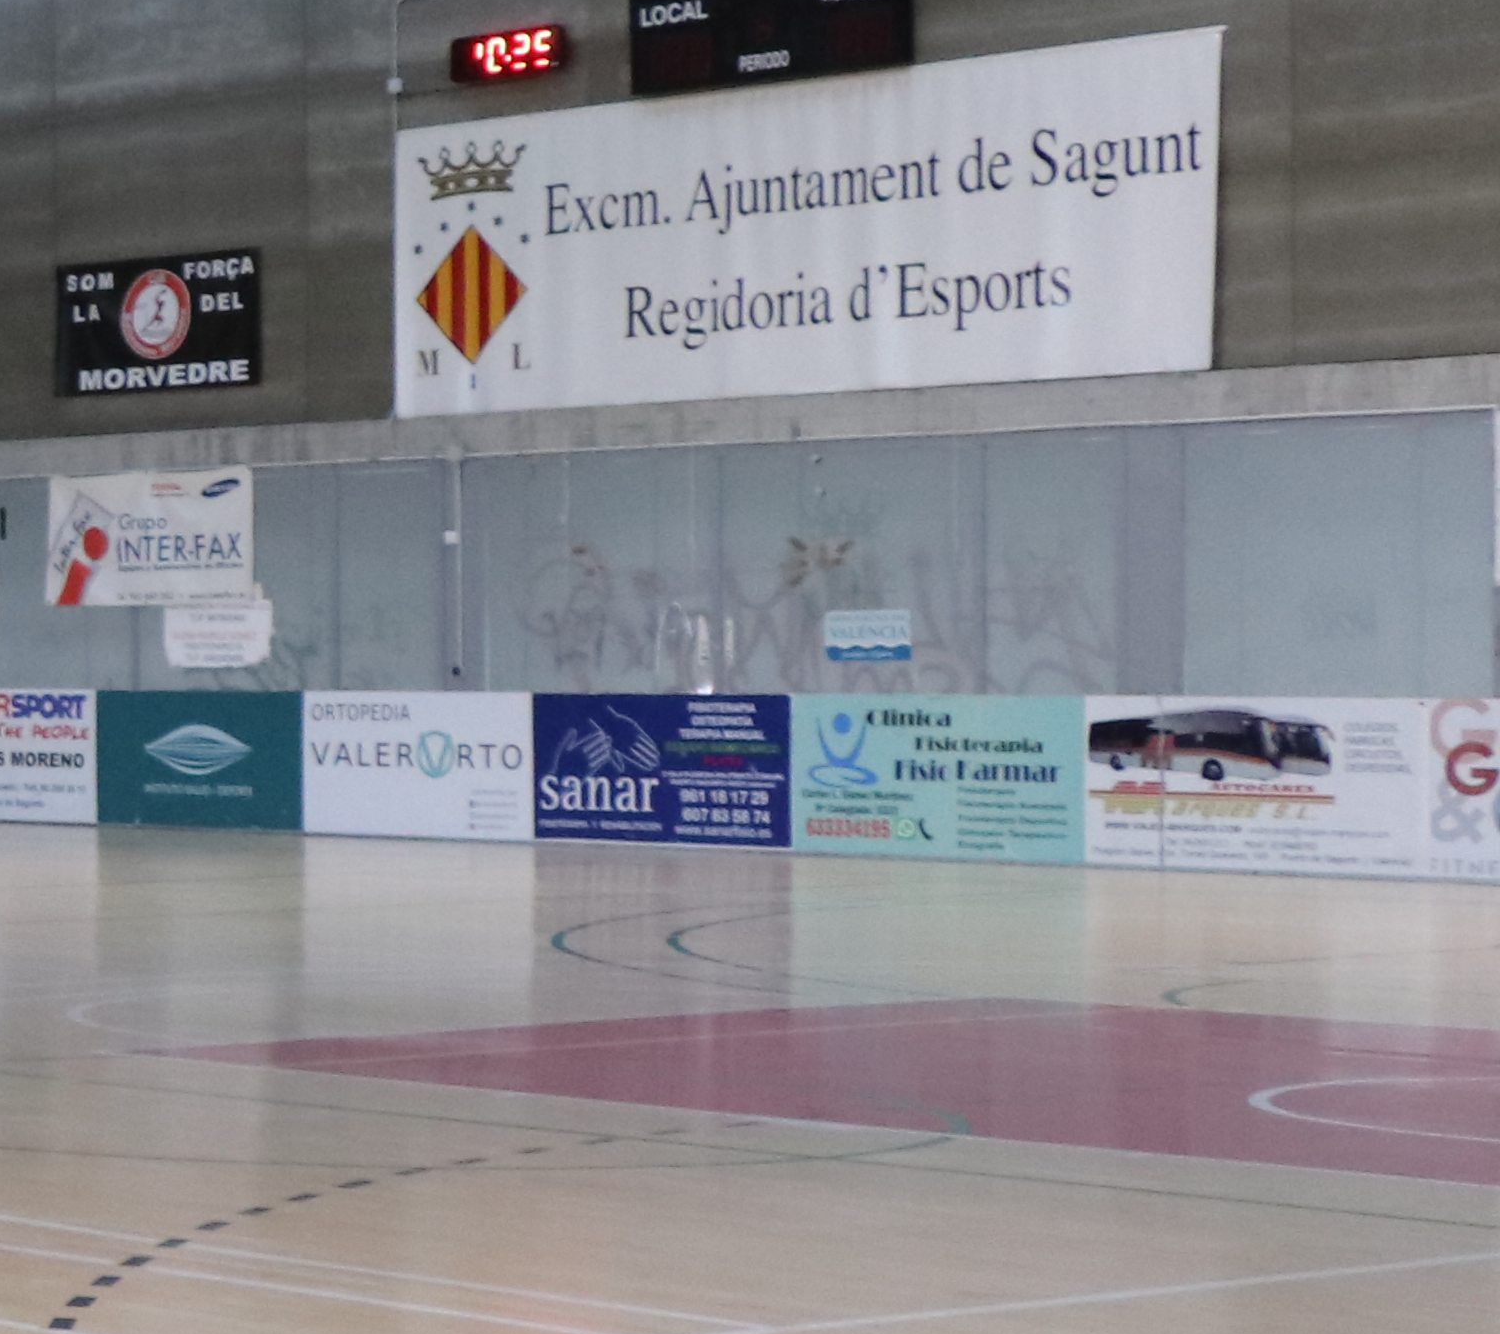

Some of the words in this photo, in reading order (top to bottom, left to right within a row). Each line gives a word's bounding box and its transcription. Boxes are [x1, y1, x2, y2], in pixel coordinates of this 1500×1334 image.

[639, 0, 708, 29] LOCAL
[738, 50, 790, 73] PERIODO
[544, 183, 671, 237] Excm.
[685, 151, 940, 236] Ajuntament
[958, 136, 1012, 194] de
[1030, 122, 1202, 198] Sagunt
[182, 256, 255, 281] FORÇA
[66, 272, 115, 292] SOM
[200, 292, 244, 312] DEL
[625, 272, 833, 349] Regidoria
[72, 304, 101, 323] LA
[78, 358, 250, 391] MORVEDRE
[118, 513, 168, 530] Grupo
[117, 532, 242, 563] INTER-FAX
[312, 703, 410, 722] ORTOPEDIA
[32, 723, 90, 740] PEOPLE
[915, 735, 1043, 754] Fisioterapia
[11, 751, 85, 768] MORENO
[894, 759, 946, 782] Fisio
[956, 759, 1059, 784] Farmar
[540, 774, 660, 812] sanar
[1211, 782, 1316, 794] AUTOCARES
